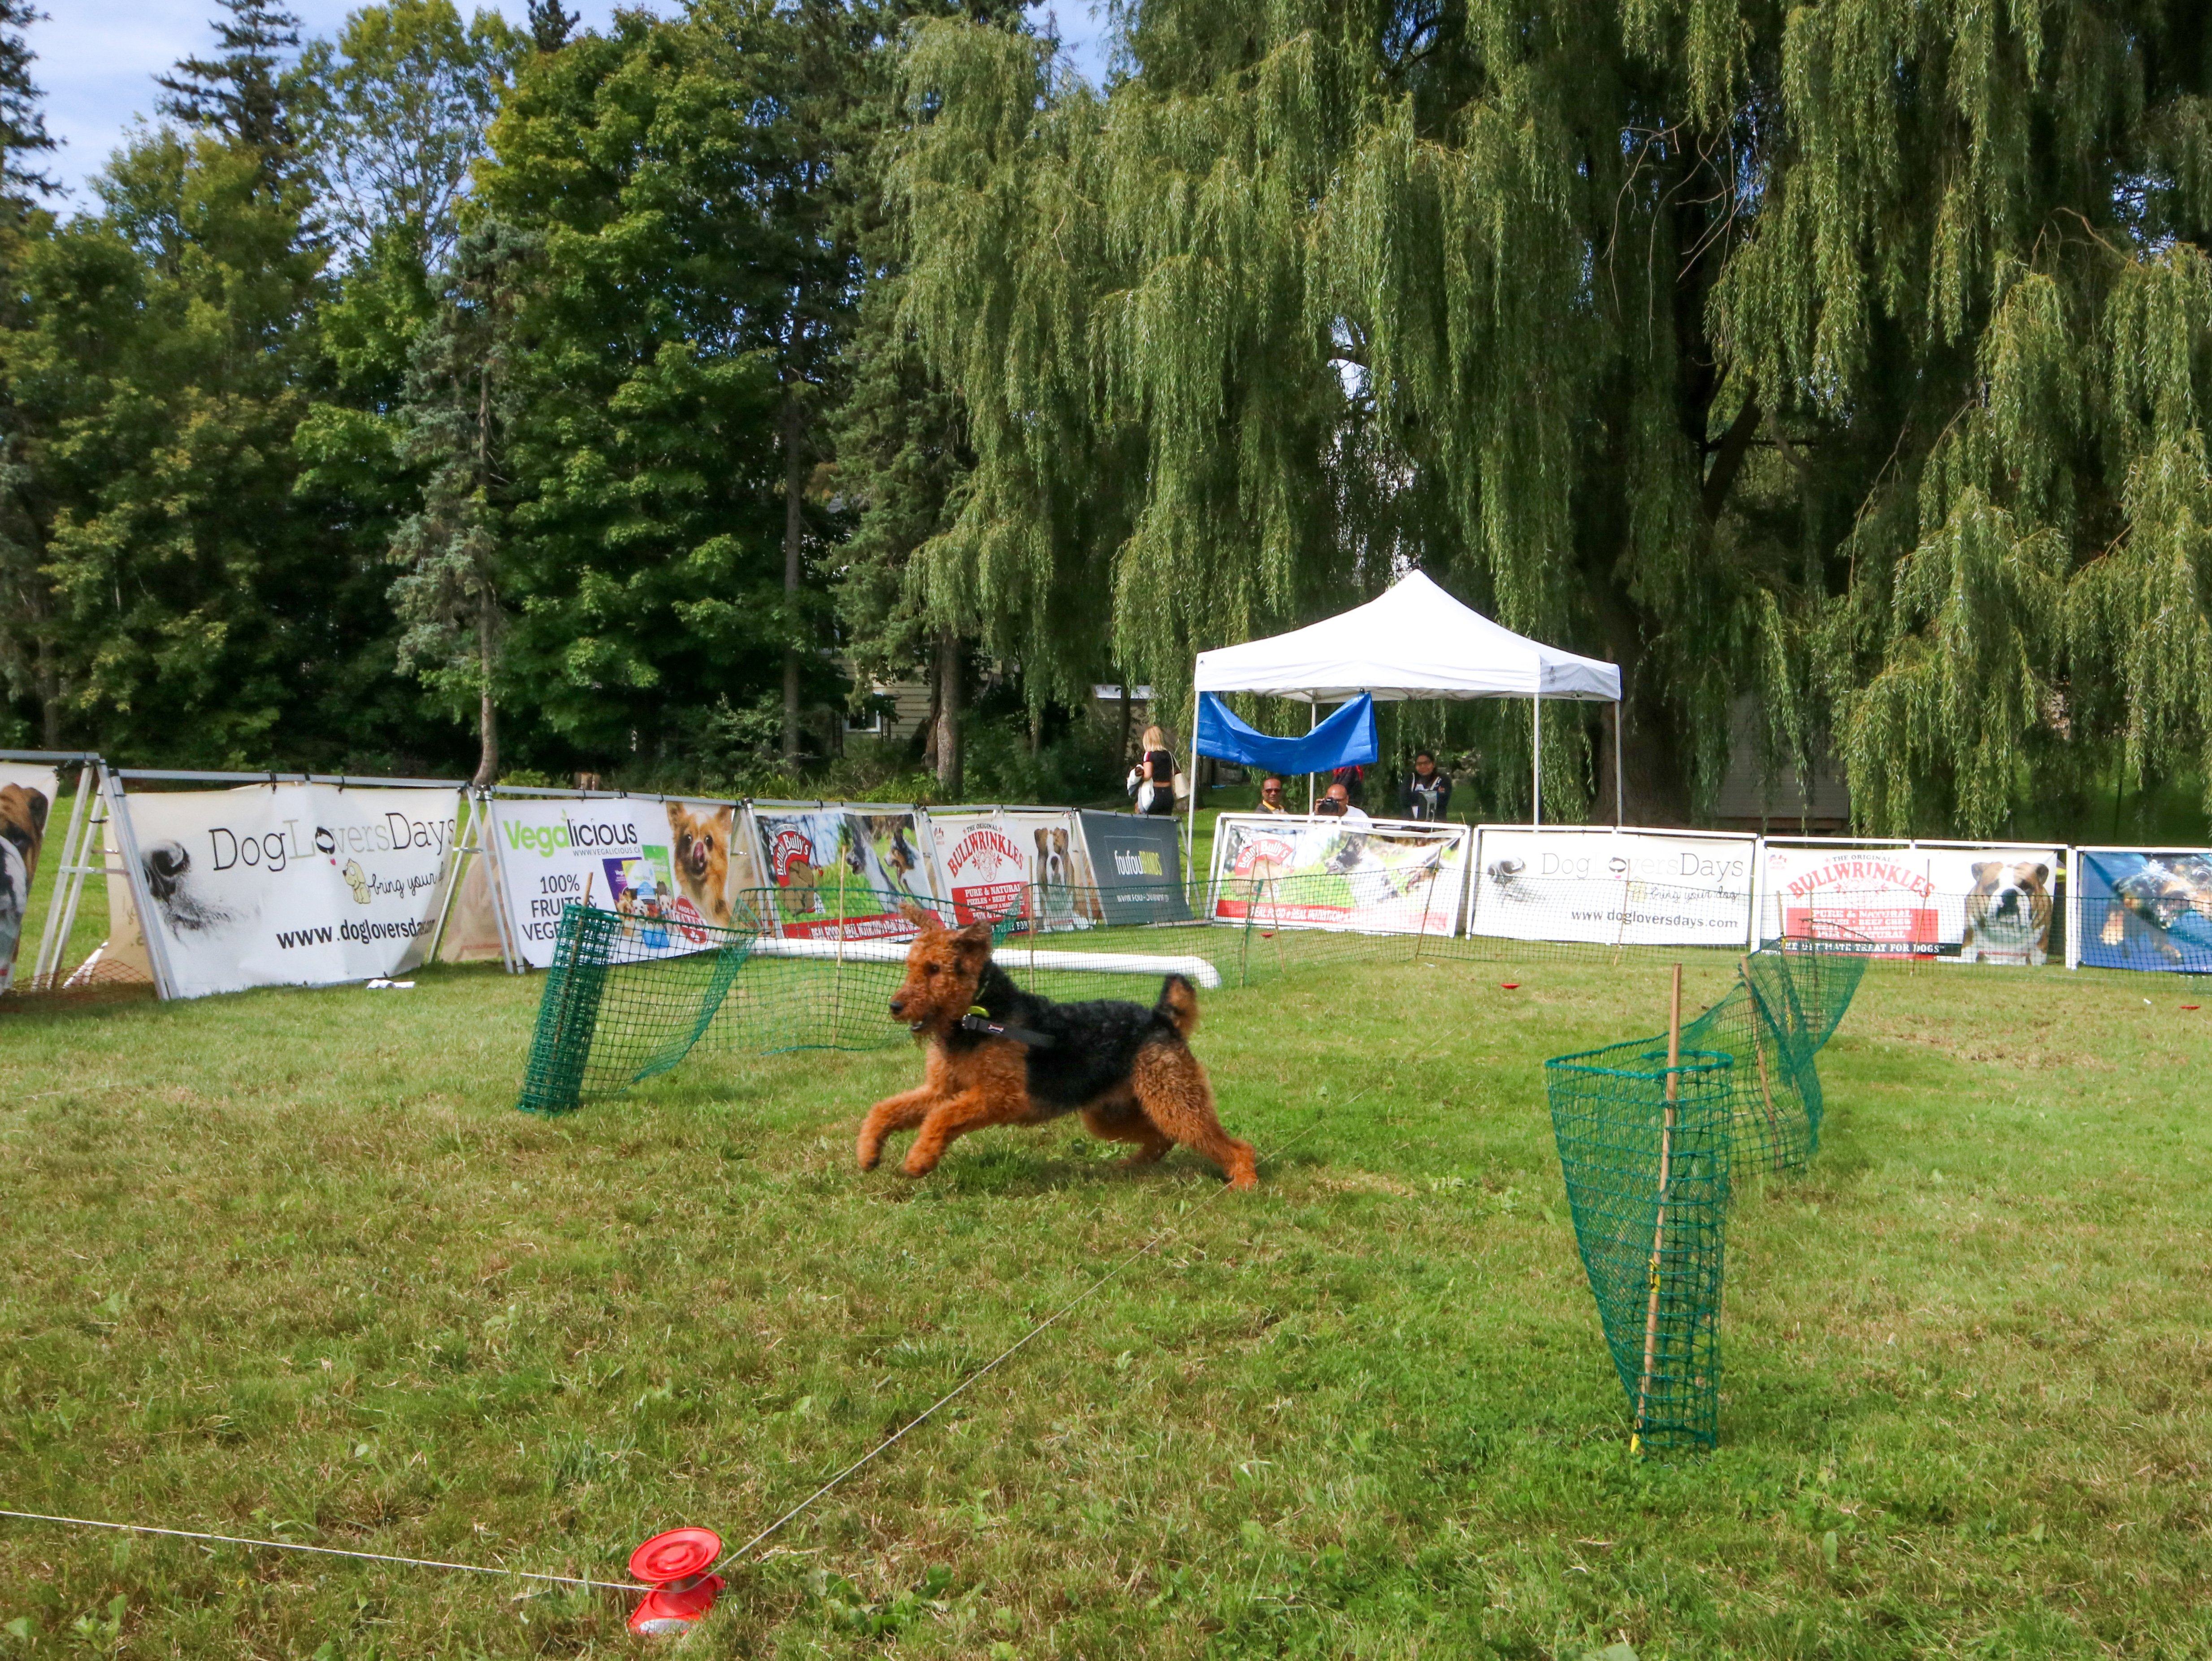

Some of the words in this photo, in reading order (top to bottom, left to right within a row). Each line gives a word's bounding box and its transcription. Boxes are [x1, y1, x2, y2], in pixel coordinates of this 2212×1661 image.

[503, 818, 638, 857] Vegalicious
[967, 824, 976, 833] THE
[976, 823, 998, 831] ORIGINAL
[573, 848, 641, 857] WWW.VEGALICIOUS.CA
[782, 834, 809, 856] Bully's
[947, 831, 1024, 878] BULLWRINKLES
[1238, 844, 1259, 868] Benny
[1260, 840, 1289, 858] Bully's
[777, 840, 788, 875] Benny
[1541, 852, 1744, 882] DogLoversDays
[407, 873, 437, 896] your
[540, 874, 580, 894] 100%
[965, 888, 983, 897] PURE
[984, 887, 990, 896] &
[1787, 862, 1936, 900] BULLWRINKLES
[1812, 909, 1844, 918] PURE
[1858, 909, 1912, 918] NATURAL
[1889, 943, 1910, 952] FOR
